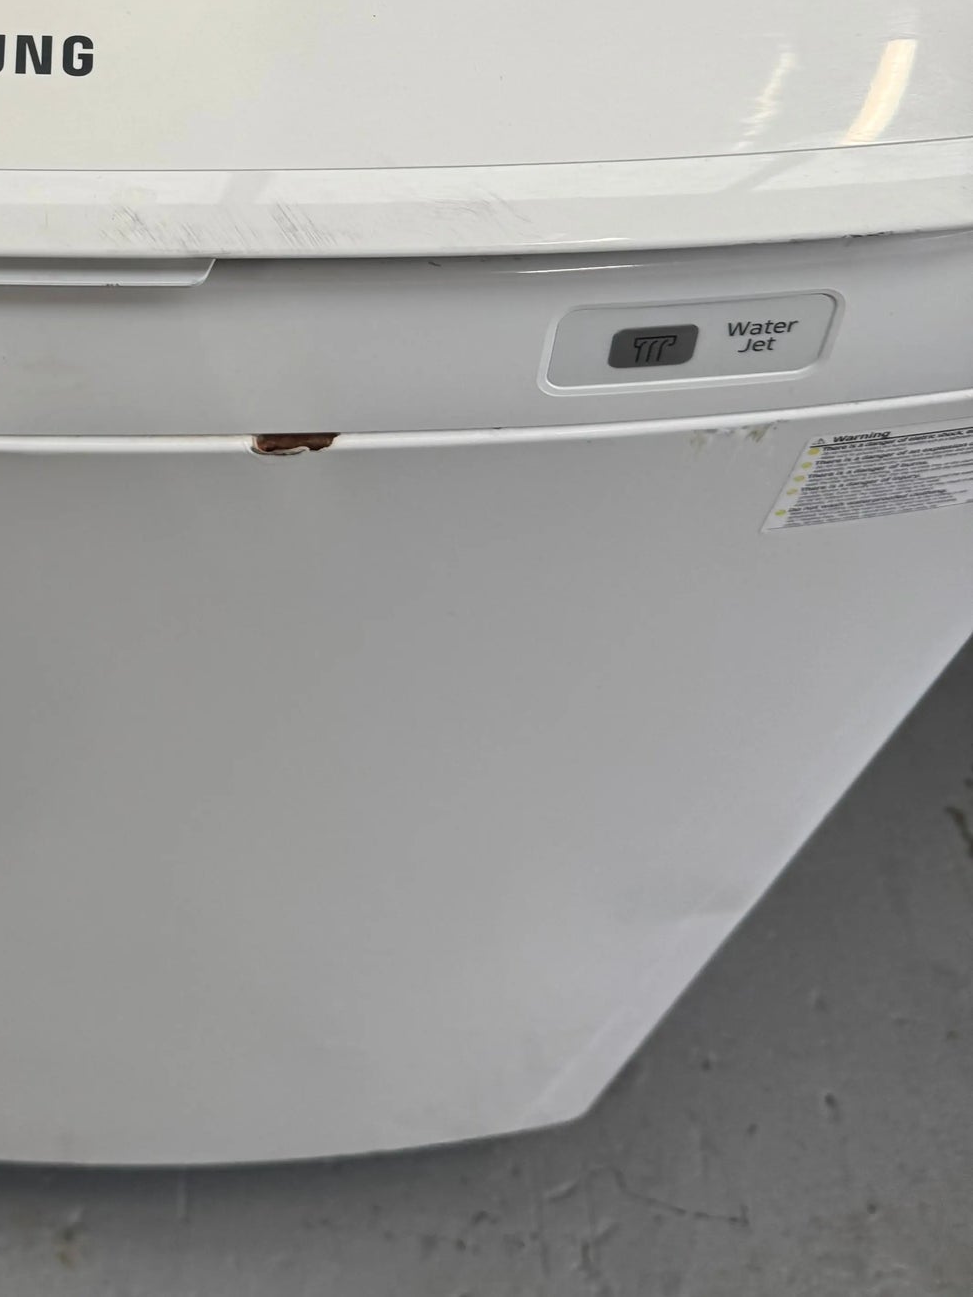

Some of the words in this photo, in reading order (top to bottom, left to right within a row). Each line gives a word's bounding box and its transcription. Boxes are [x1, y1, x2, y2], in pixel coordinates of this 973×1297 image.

[727, 319, 799, 337] Water
[737, 336, 777, 353] Jet
[833, 431, 891, 443] Warning
